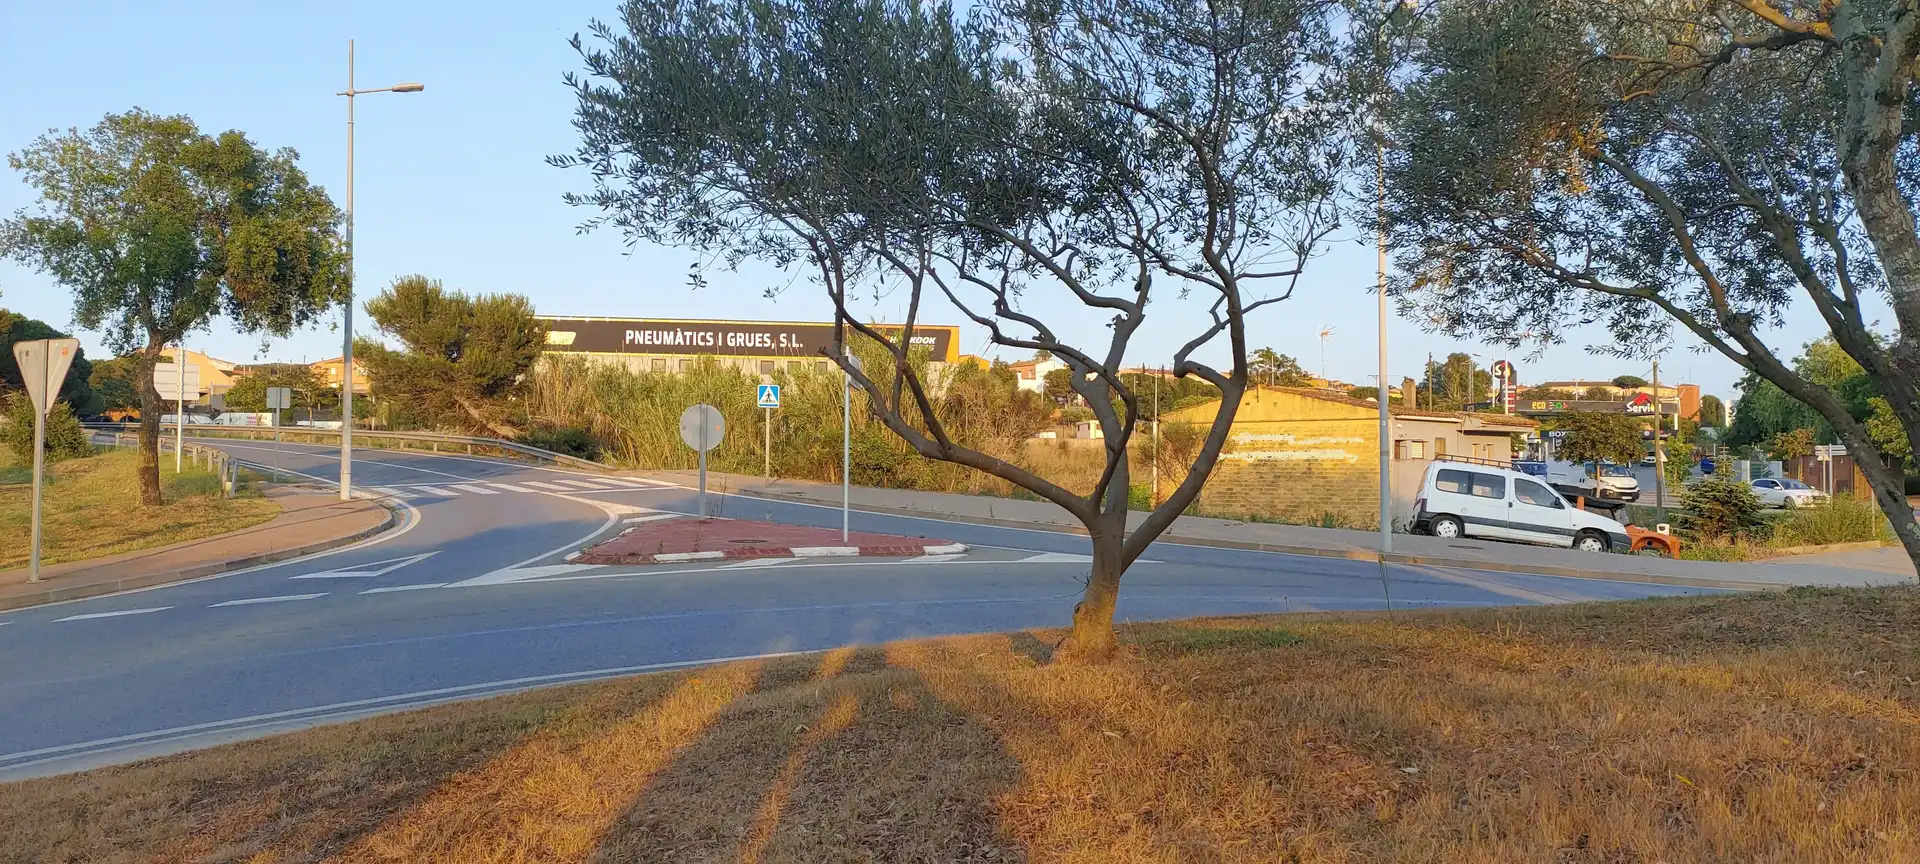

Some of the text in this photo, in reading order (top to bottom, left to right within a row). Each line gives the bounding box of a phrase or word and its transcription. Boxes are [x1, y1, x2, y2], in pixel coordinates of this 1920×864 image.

[625, 328, 804, 350] PNEUMÀTICS I GRUES, S.L.
[889, 336, 937, 345] HKOOK
